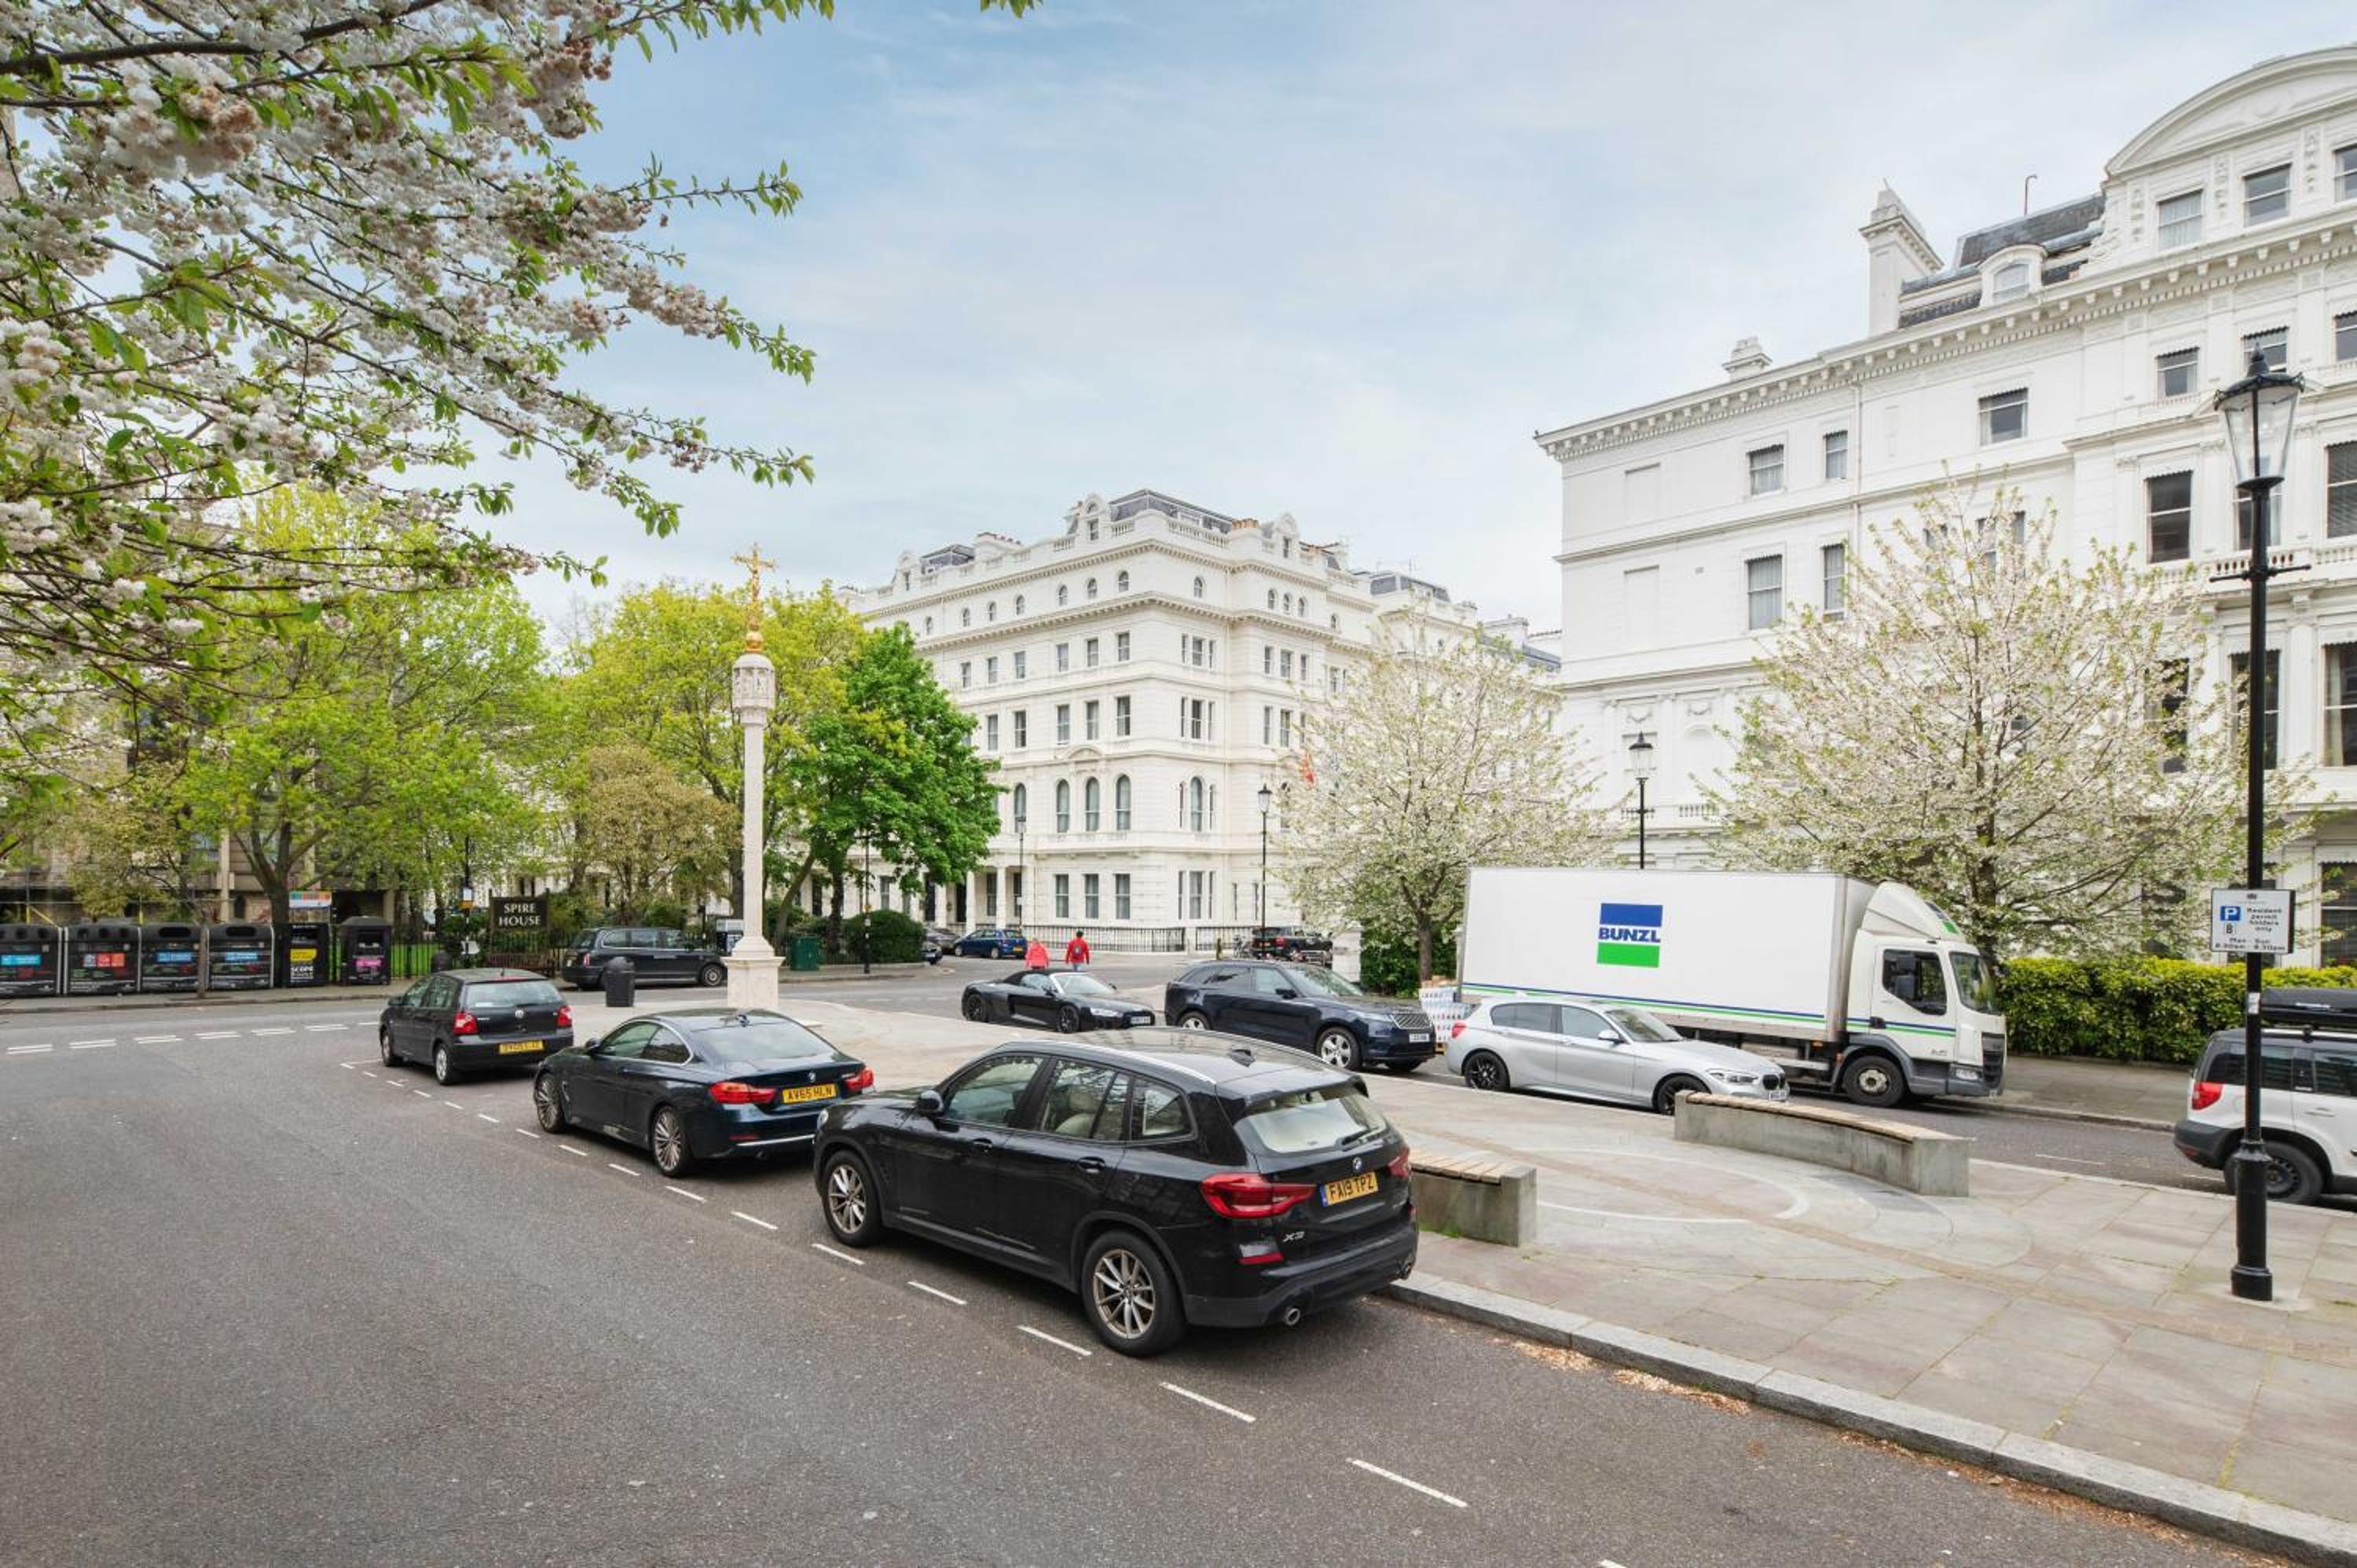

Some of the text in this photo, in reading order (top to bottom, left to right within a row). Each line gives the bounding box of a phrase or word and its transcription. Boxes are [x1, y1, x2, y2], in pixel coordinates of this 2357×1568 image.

[504, 903, 537, 914] SPIRE
[2224, 907, 2238, 920] P
[499, 916, 541, 926] HOUSE
[1598, 928, 1661, 943] BUNZL
[1329, 1174, 1375, 1200] FA19 TPZ
[1282, 1231, 1305, 1242] X3
